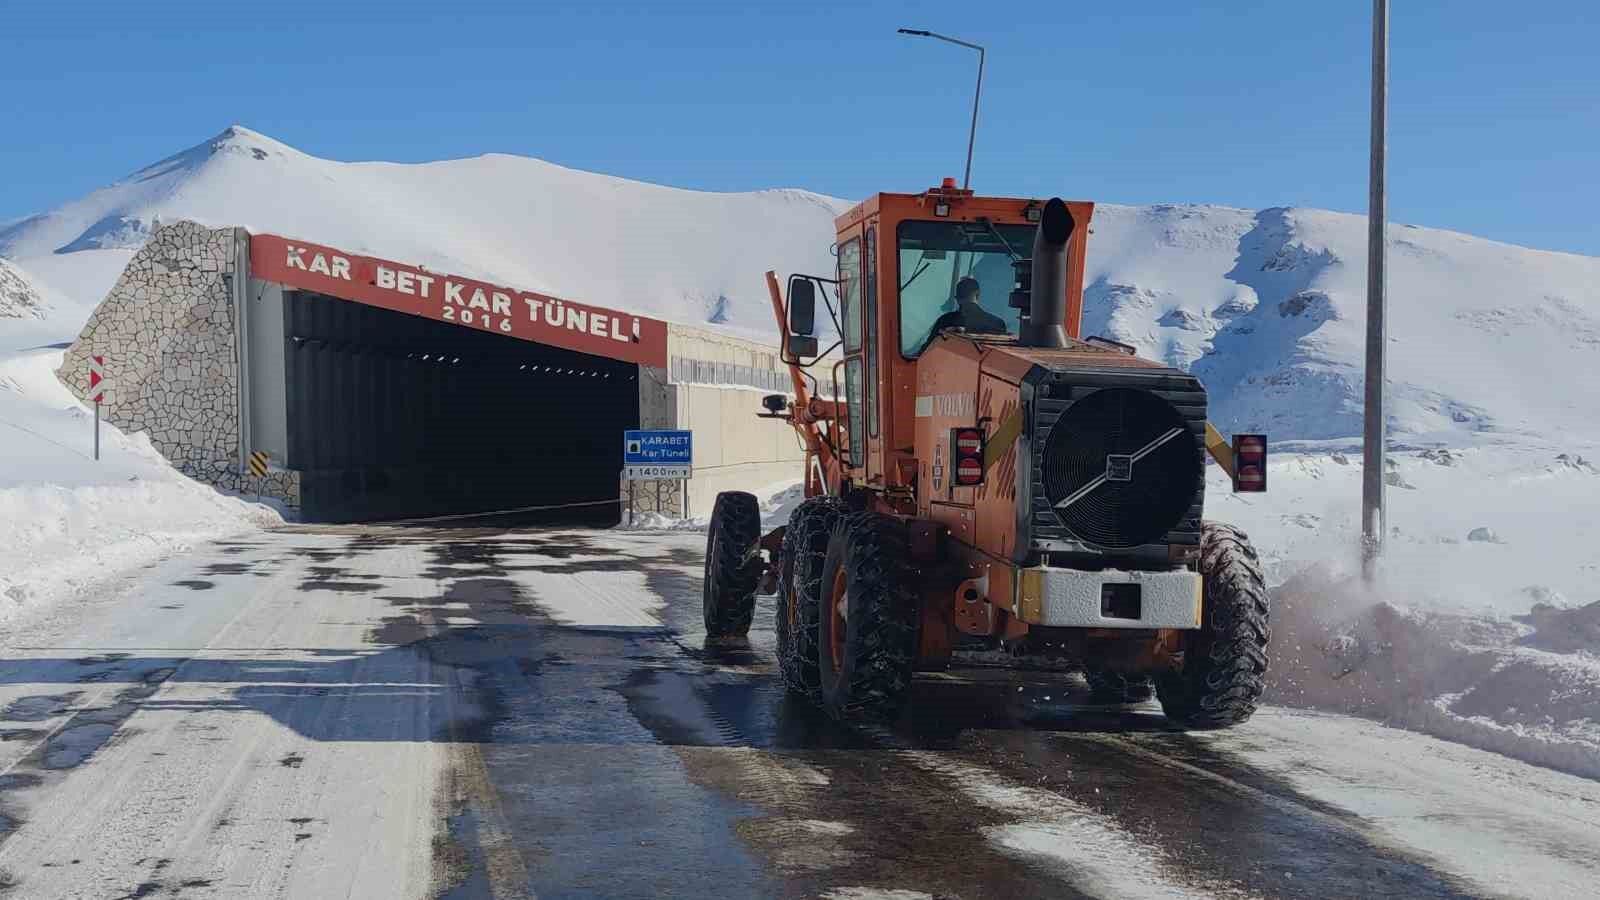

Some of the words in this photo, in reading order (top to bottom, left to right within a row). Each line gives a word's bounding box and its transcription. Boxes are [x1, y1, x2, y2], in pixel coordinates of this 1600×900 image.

[444, 281, 512, 317] KAR
[442, 305, 513, 332] 2016
[641, 436, 689, 445] KARABET
[640, 467, 678, 476] 1400m
